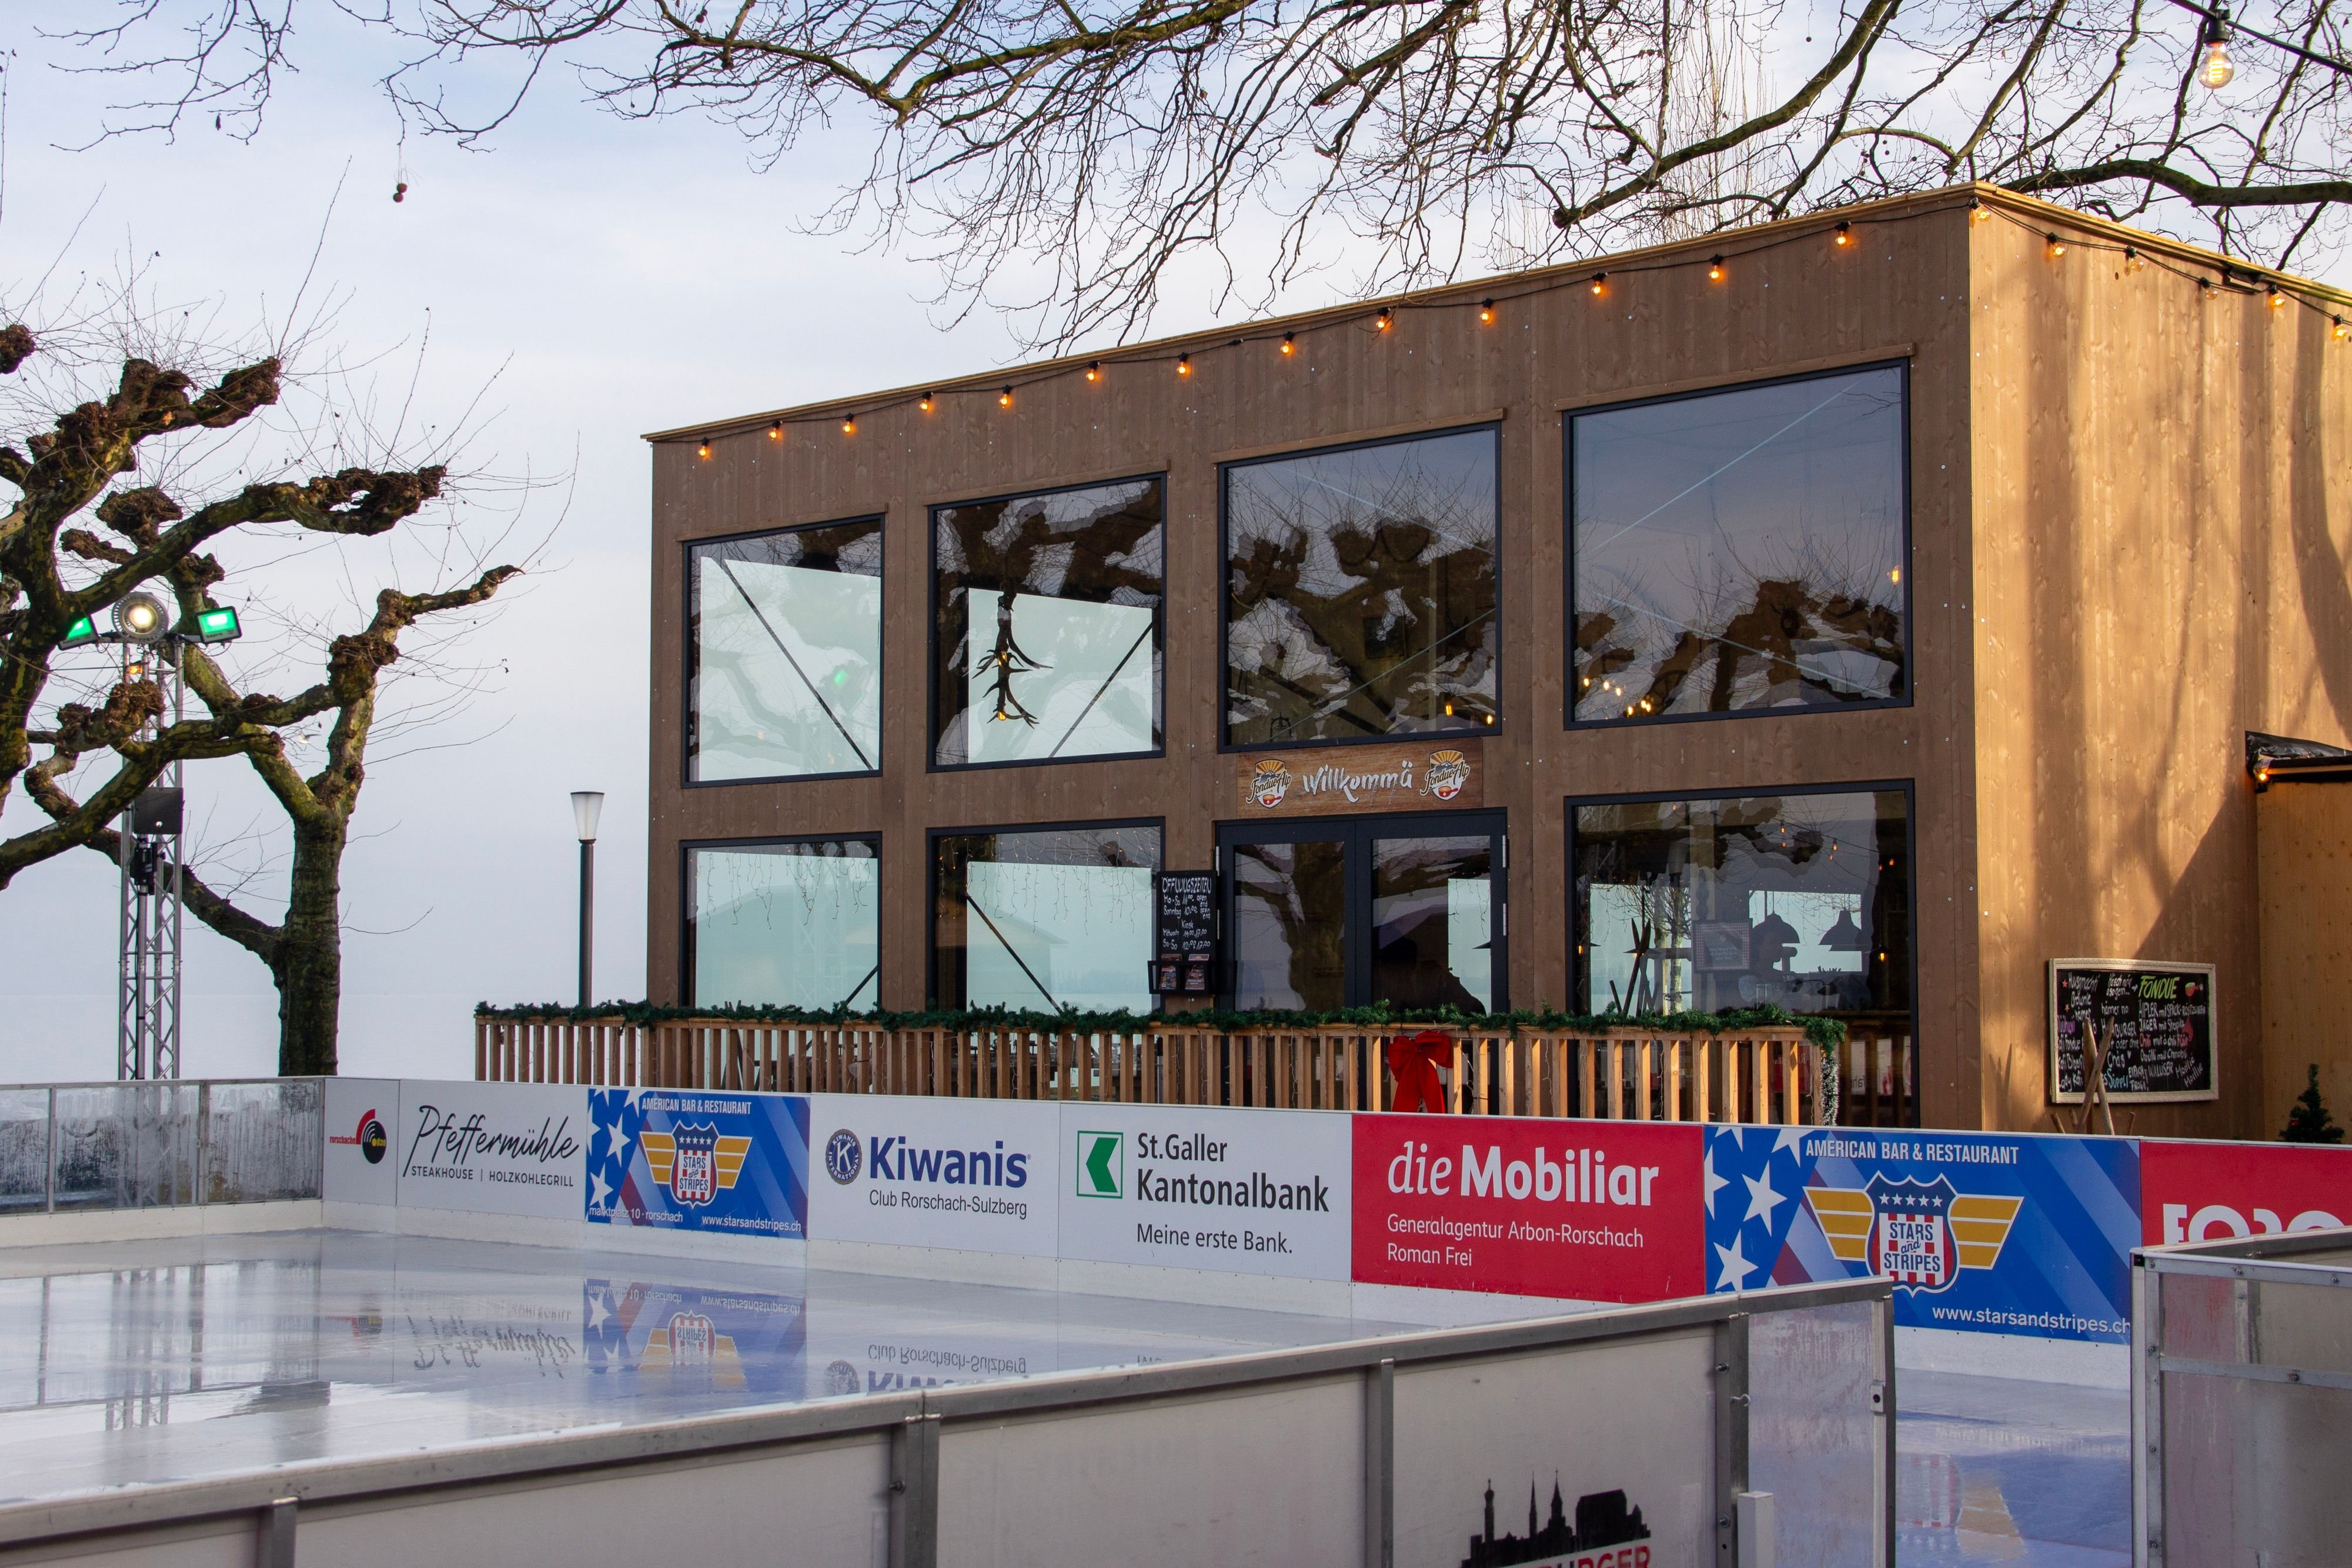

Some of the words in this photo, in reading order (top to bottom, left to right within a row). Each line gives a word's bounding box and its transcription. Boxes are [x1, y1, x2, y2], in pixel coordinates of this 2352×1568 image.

[1303, 760, 1412, 803] Willkommä
[1162, 877, 1212, 894] ÖFFNUNGSZEITEN
[1164, 905, 1181, 918] Sonntag
[1181, 920, 1194, 929] Kiosk
[2138, 975, 2180, 999] FONDUE
[2121, 1005, 2129, 1015] no
[2116, 1039, 2127, 1049] oder
[642, 1098, 679, 1111] AMERICAN
[681, 1099, 696, 1112] BAR
[697, 1101, 703, 1112] &
[704, 1101, 751, 1115] RESTAURANT
[403, 1105, 580, 1177] Pfeffermühle
[832, 1134, 856, 1147] KIWANIS
[1806, 1139, 1876, 1159] AMERICAN
[1882, 1142, 1909, 1161] BAR
[1912, 1144, 1923, 1161] &
[1926, 1144, 2019, 1165] RESTAURANT
[683, 1156, 706, 1170] STARS
[828, 1151, 859, 1180] INTERNATIONAL
[412, 1166, 473, 1179] STEAKHOUSE
[489, 1171, 574, 1187] HOLZKOHLEGRILL
[689, 1168, 699, 1179] and
[1388, 1141, 1452, 1196] die
[1461, 1144, 1659, 1206] Mobiliar
[679, 1178, 709, 1191] STRIPES
[1137, 1168, 1329, 1213] Kantonalbank
[870, 1189, 897, 1206] Club
[902, 1192, 1027, 1219] Rorschach-Sulzberg
[631, 1208, 640, 1219] 10
[646, 1211, 683, 1222] rorschach
[701, 1215, 801, 1232] www.starsandstripes.ch
[1137, 1223, 1190, 1246] Meine
[1195, 1231, 1237, 1249] erste
[1244, 1232, 1292, 1254] Bank.
[1388, 1213, 1503, 1241] Generalagentur
[1508, 1221, 1644, 1248] Arbon-Rorschach
[1889, 1222, 1933, 1242] STARS
[1388, 1243, 1440, 1264] Roman
[1446, 1246, 1472, 1266] Frei
[1900, 1236, 1921, 1253] and
[1884, 1253, 1940, 1273] STRIPES
[1932, 1306, 2130, 1335] www.starsandstripes.ch
